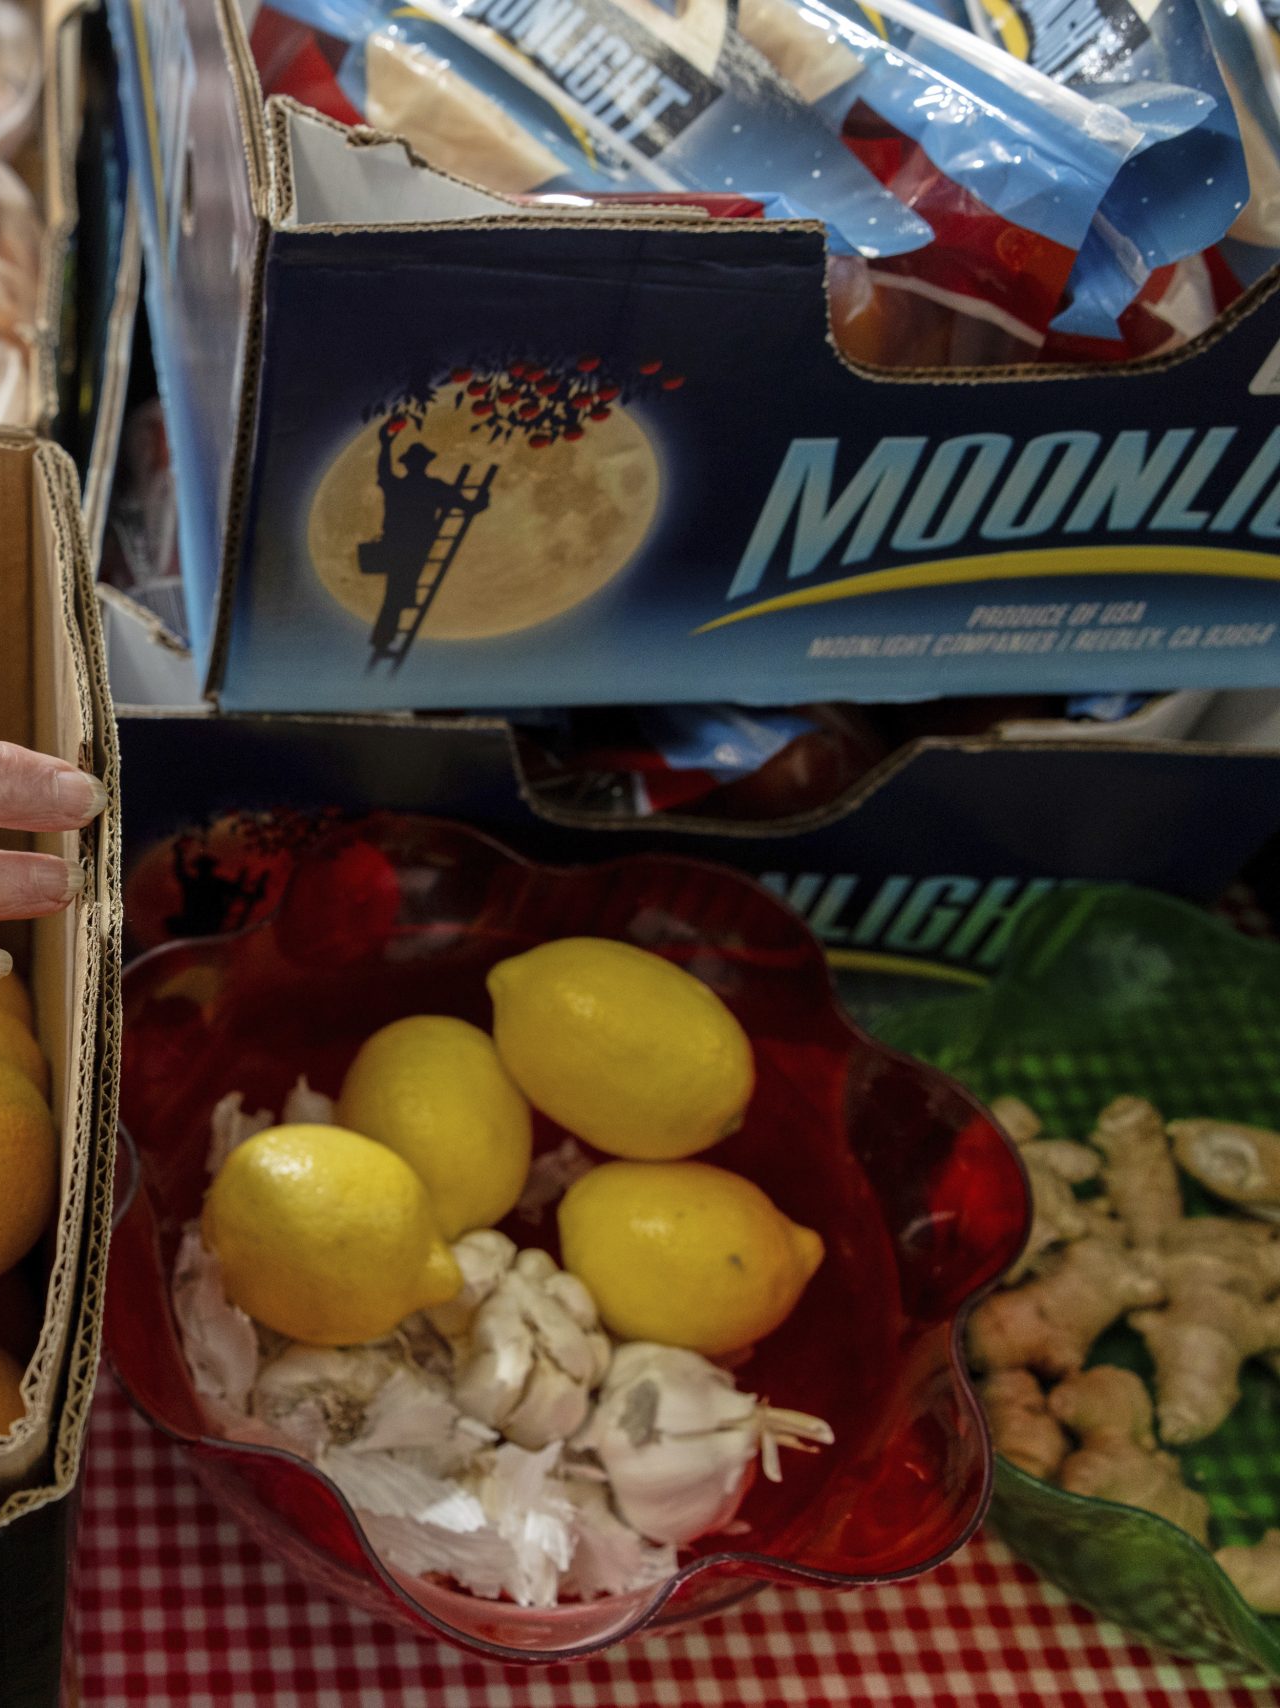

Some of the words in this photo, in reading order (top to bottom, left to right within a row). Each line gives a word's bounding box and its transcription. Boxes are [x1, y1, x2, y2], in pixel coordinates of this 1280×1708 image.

[468, 0, 692, 142] NLIGHT
[726, 426, 1280, 600] MOONLI
[805, 633, 935, 659] MOONLIGHT
[931, 630, 1060, 657] COMPANIES
[1167, 624, 1205, 649] CA
[967, 603, 1070, 629] PRODUCE
[1067, 602, 1103, 627] OF
[1099, 601, 1148, 625] USA
